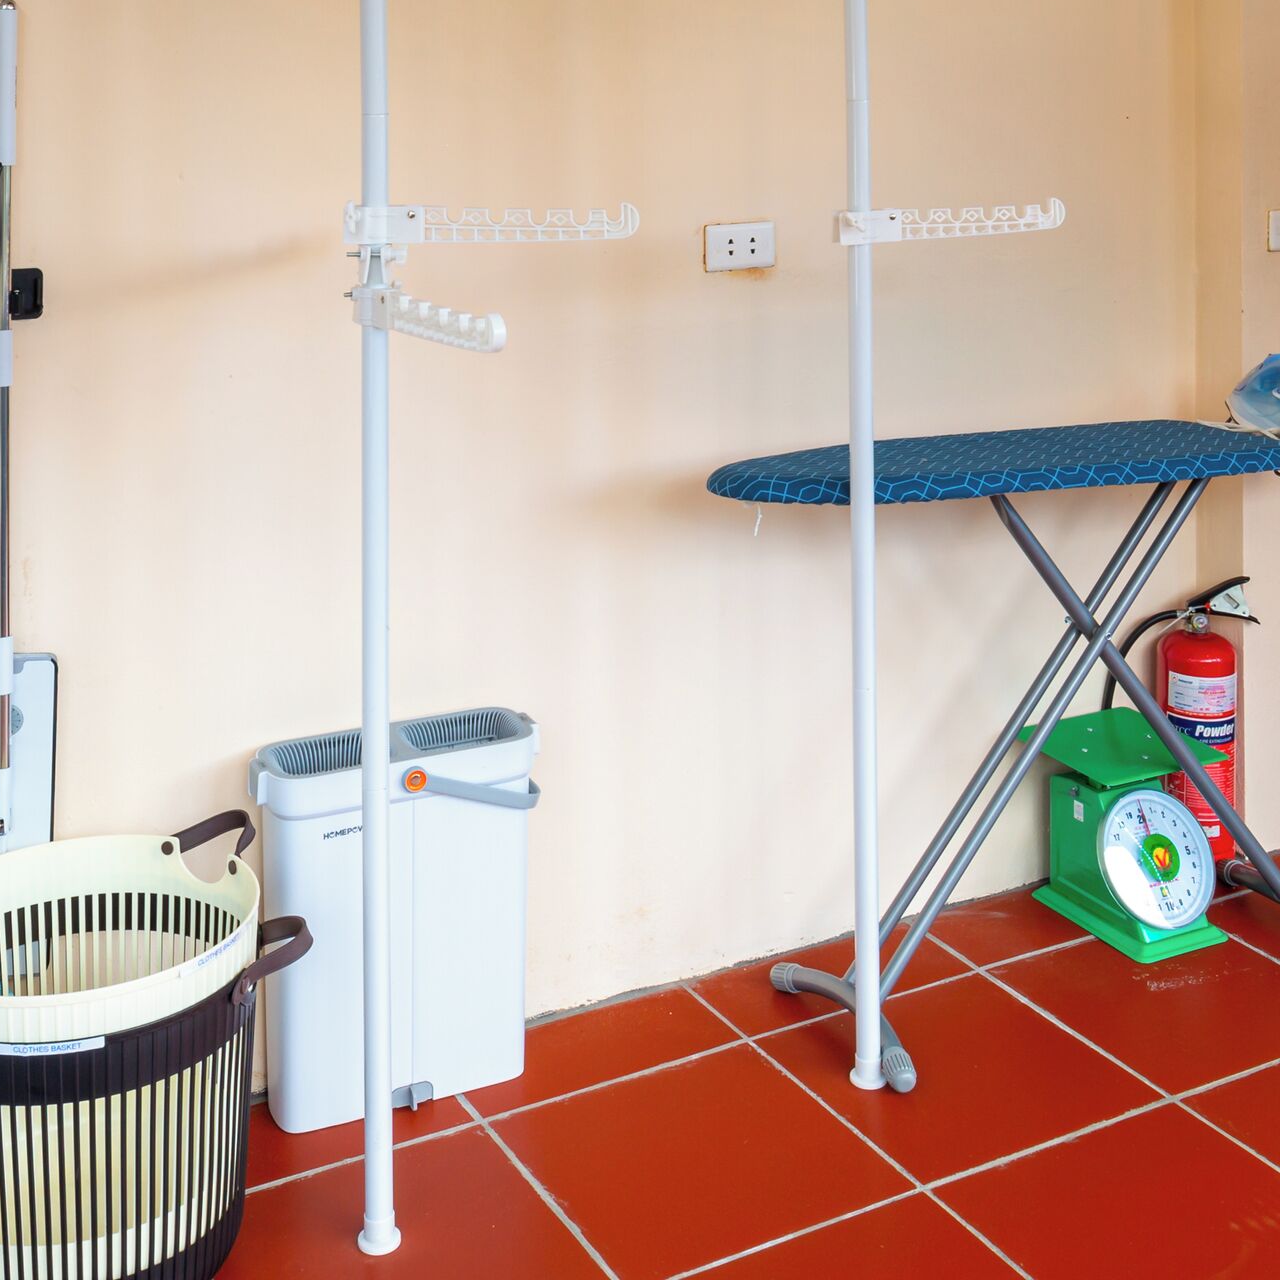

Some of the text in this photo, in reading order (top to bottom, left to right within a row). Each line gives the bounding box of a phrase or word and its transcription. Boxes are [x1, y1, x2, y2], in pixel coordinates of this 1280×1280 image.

[1195, 723, 1235, 738] Powder
[1184, 845, 1191, 855] 5
[13, 1042, 81, 1054] CLOTHES BASKET
